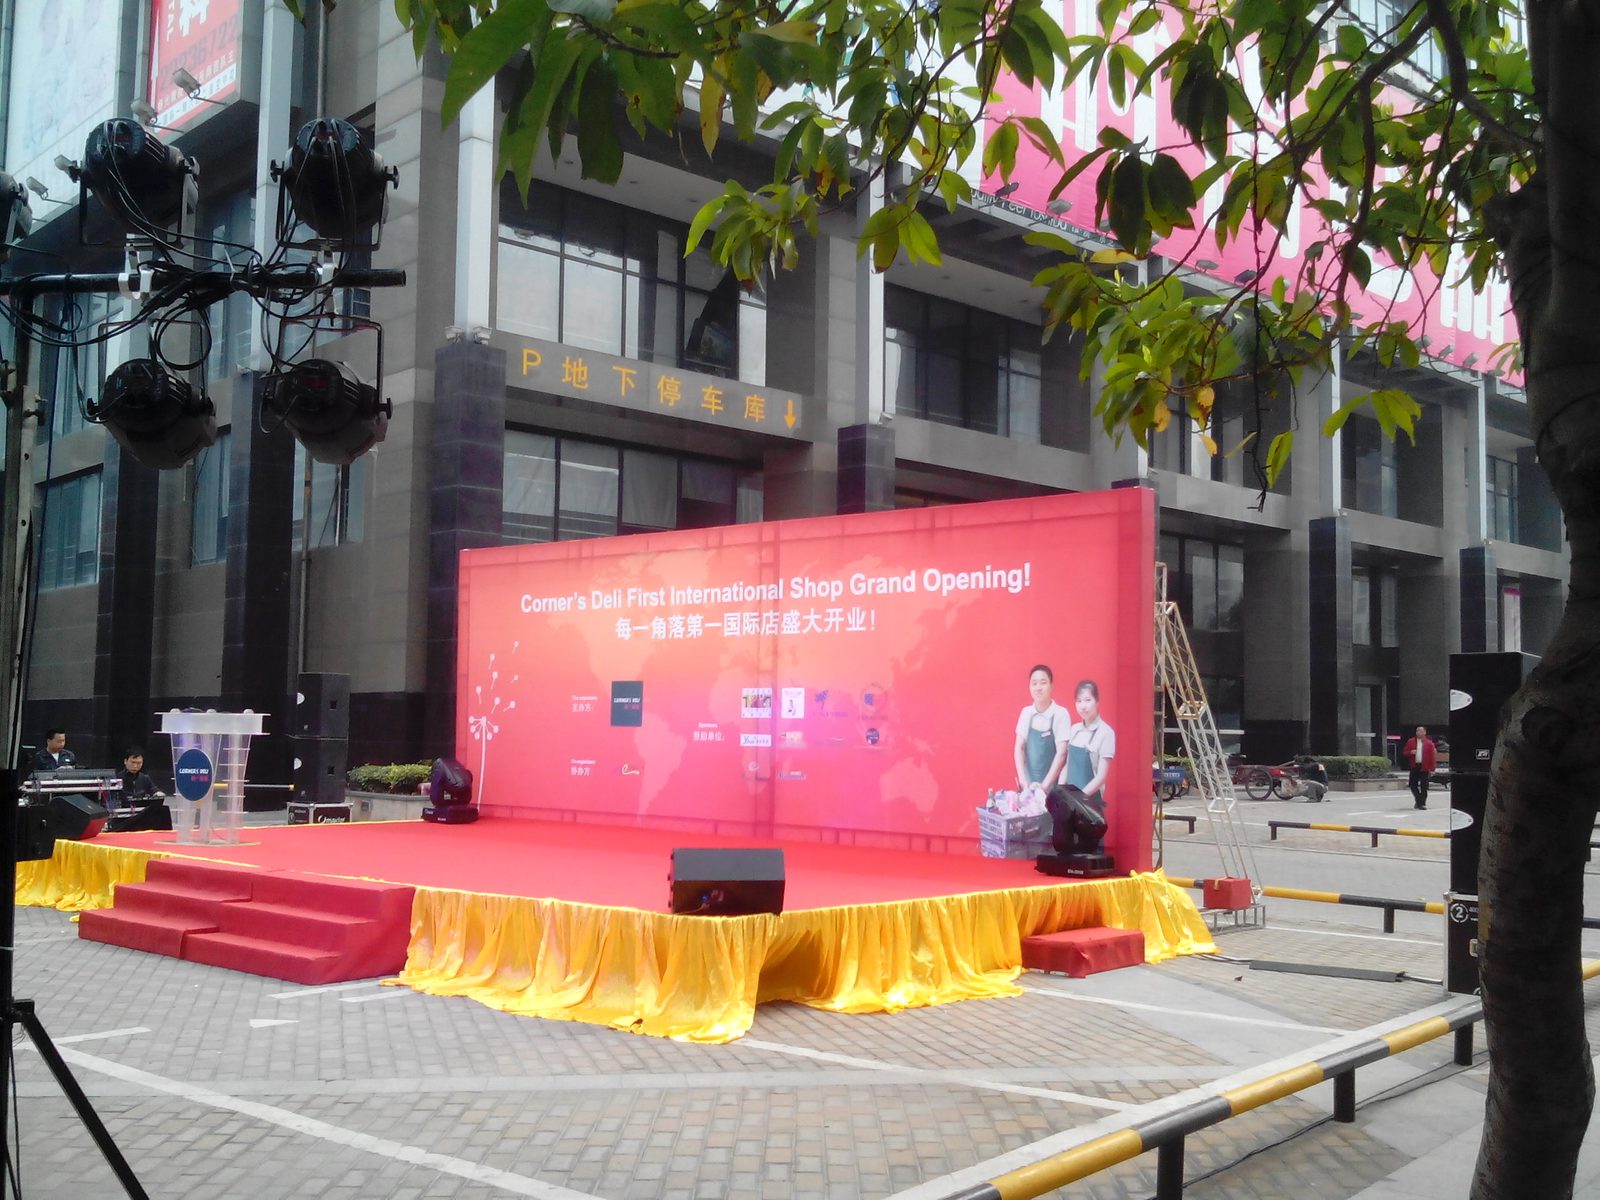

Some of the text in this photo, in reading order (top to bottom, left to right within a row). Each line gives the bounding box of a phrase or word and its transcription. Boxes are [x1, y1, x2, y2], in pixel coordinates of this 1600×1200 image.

[521, 348, 766, 423] P 地下停车库
[521, 562, 1031, 613] Corner's Deli First International Shop Grand Opening!
[615, 606, 876, 641] 每一角落第一国际店盛大开业！
